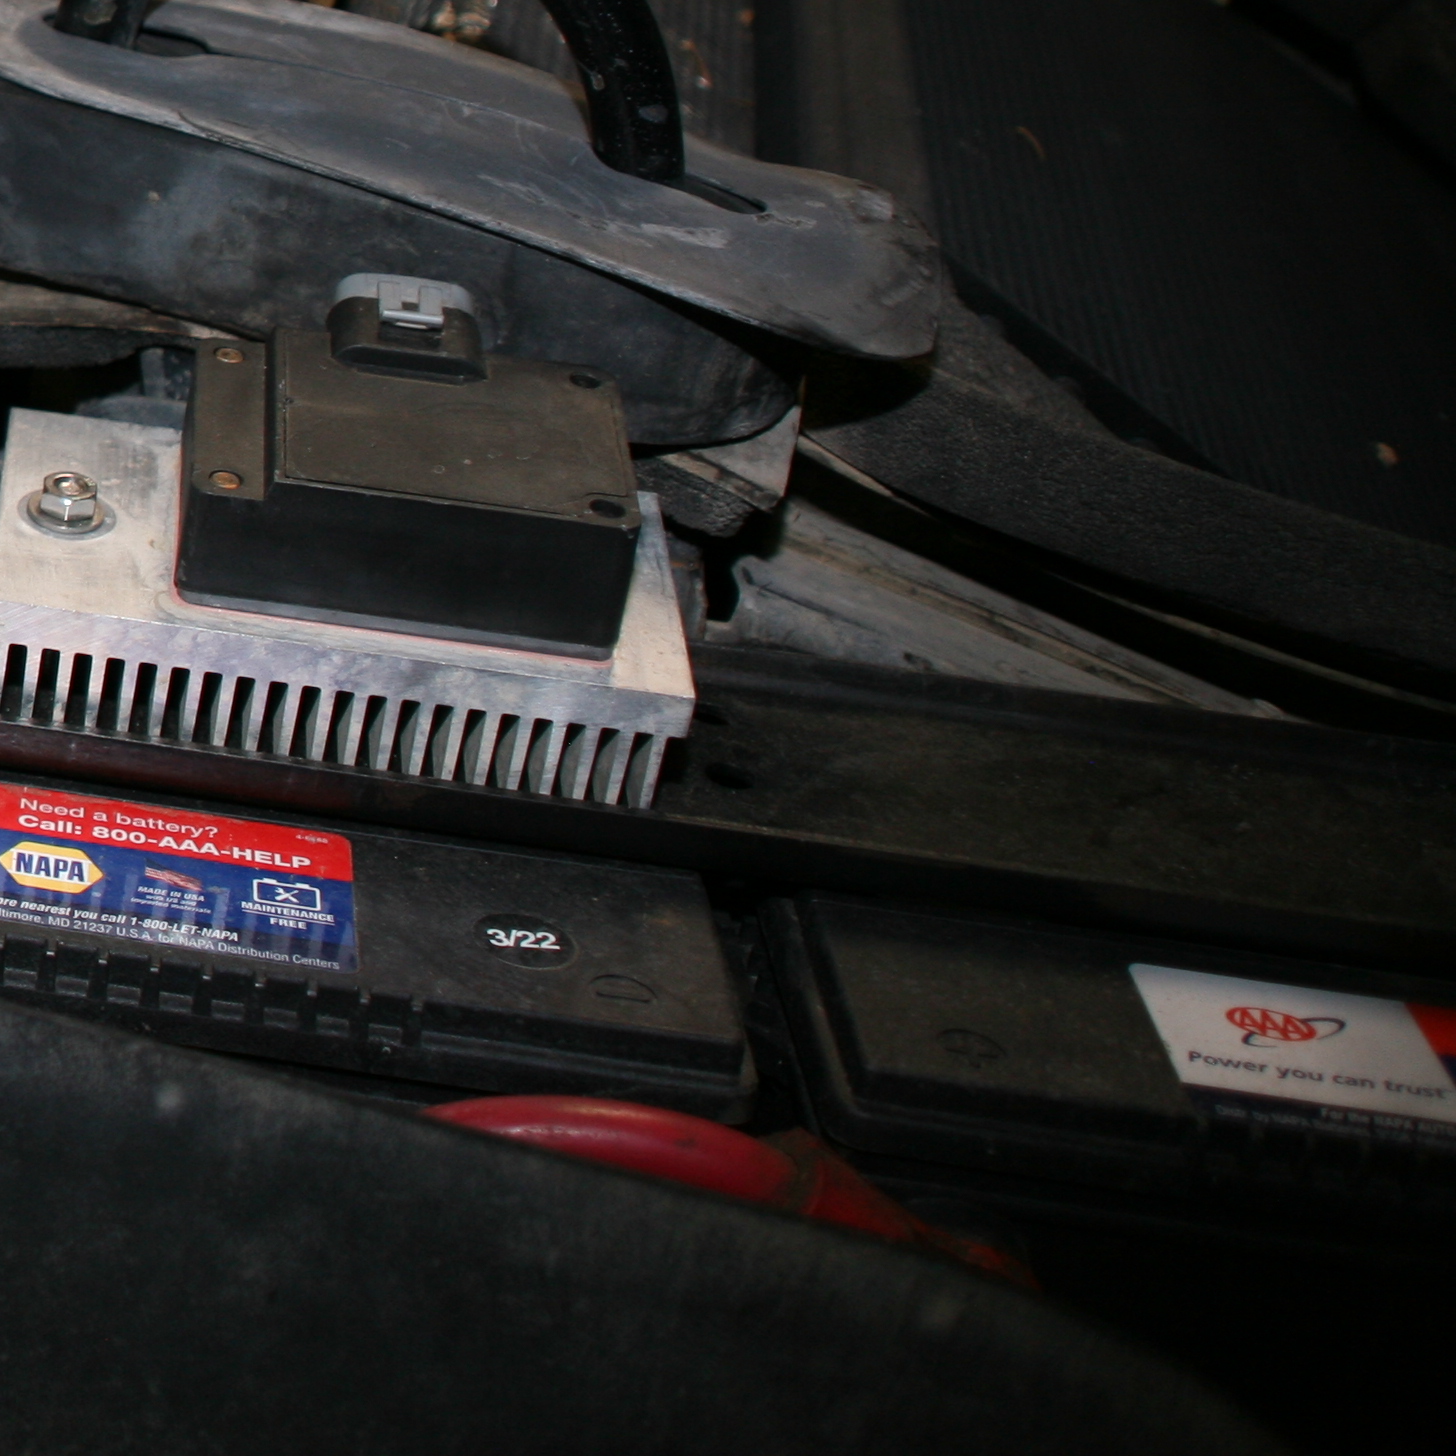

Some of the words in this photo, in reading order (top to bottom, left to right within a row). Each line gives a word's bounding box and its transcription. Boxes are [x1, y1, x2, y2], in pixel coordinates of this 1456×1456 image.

[19, 797, 85, 819] Need
[92, 811, 108, 822] a
[116, 812, 219, 839] battery?
[18, 814, 83, 835] Call:
[91, 825, 312, 869] 800-AAA-HELP
[14, 851, 87, 883] NAPA
[137, 885, 169, 896] MADE
[170, 890, 182, 898] IN
[183, 892, 205, 902] USA
[20, 899, 72, 917] nearest
[72, 908, 98, 920] you
[100, 912, 127, 924] call
[130, 916, 239, 942] 1-800-LET-NAPA
[240, 901, 336, 923] MAINTENANCE
[268, 917, 308, 930] FREE
[48, 915, 70, 928] MD
[73, 918, 113, 934] 21237
[116, 926, 153, 942] U.S.A.
[158, 932, 175, 944] for
[178, 935, 215, 951] NAPA
[217, 942, 290, 962] Distribution
[292, 953, 340, 970] Centers
[487, 928, 562, 950] 3/22
[1231, 1007, 1310, 1040] AAA
[1188, 1049, 1268, 1073] Power
[1275, 1065, 1324, 1082] you
[1331, 1073, 1376, 1089] can
